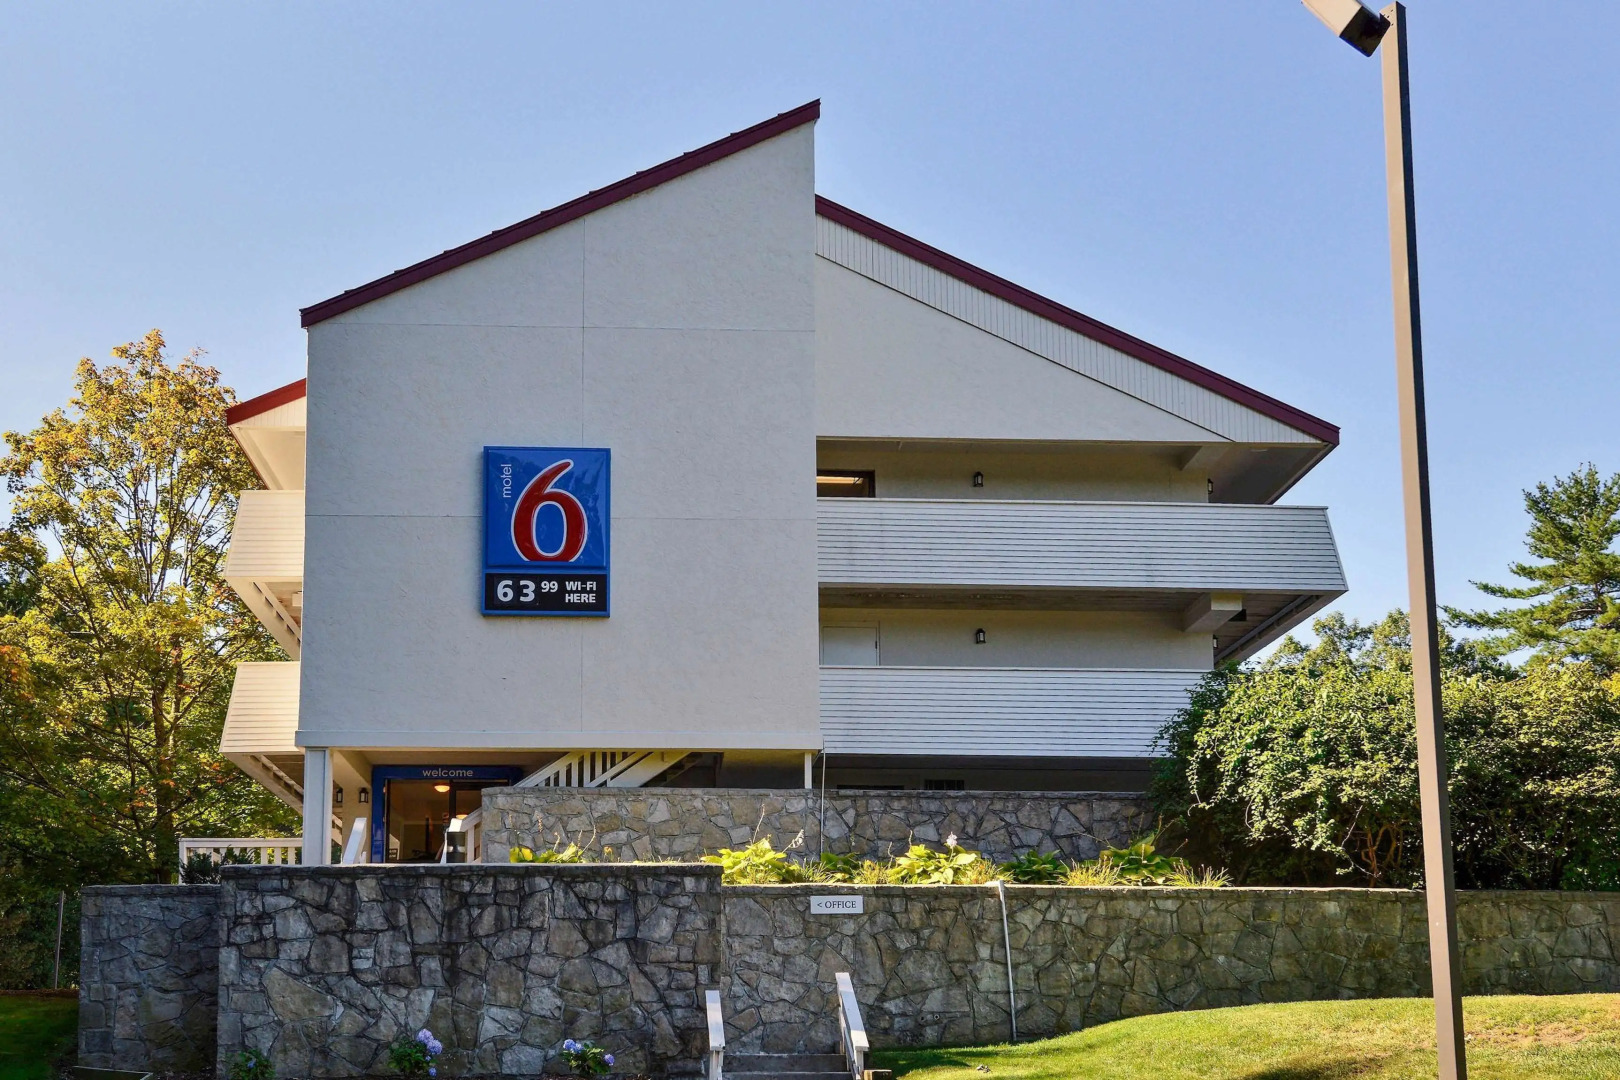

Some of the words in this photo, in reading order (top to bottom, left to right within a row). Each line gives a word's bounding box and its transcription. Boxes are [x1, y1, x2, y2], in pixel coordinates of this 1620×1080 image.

[501, 464, 512, 498] motel
[511, 459, 588, 562] 6
[497, 580, 536, 602] 63
[541, 581, 558, 592] 99
[565, 581, 597, 591] WI-FI
[565, 593, 596, 603] HERE
[422, 768, 474, 777] welcome
[824, 900, 857, 909] OFFICE
